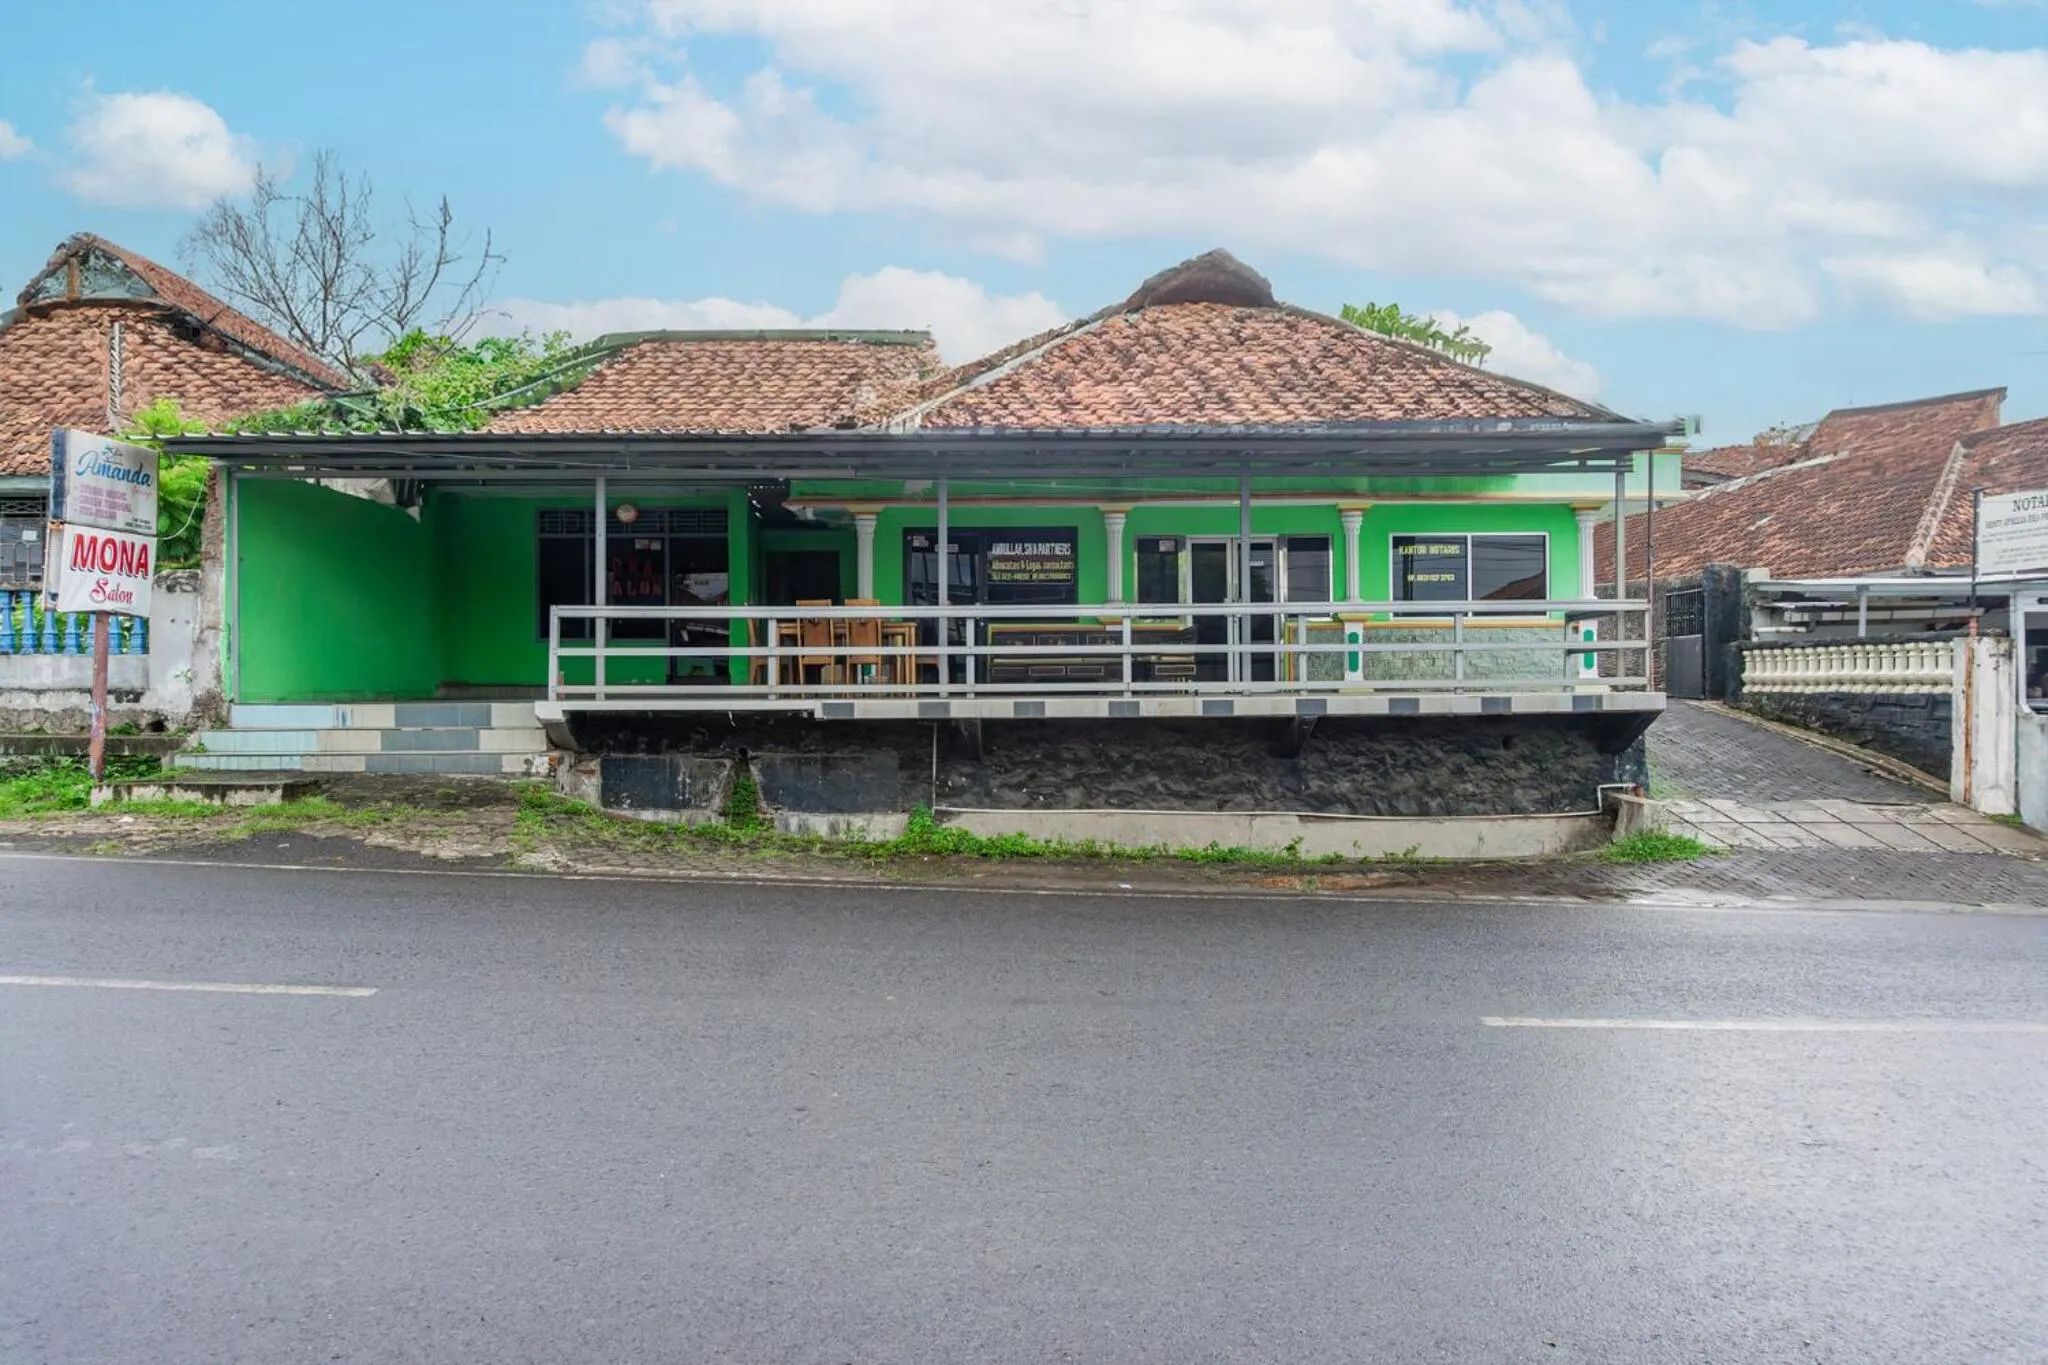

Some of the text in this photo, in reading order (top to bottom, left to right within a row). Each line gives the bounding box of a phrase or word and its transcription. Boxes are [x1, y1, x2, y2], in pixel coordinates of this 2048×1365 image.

[75, 450, 152, 487] Amanda
[71, 532, 149, 579] MONA
[1399, 544, 1460, 555] KANTOR NOTARIS
[89, 577, 134, 604] Salon
